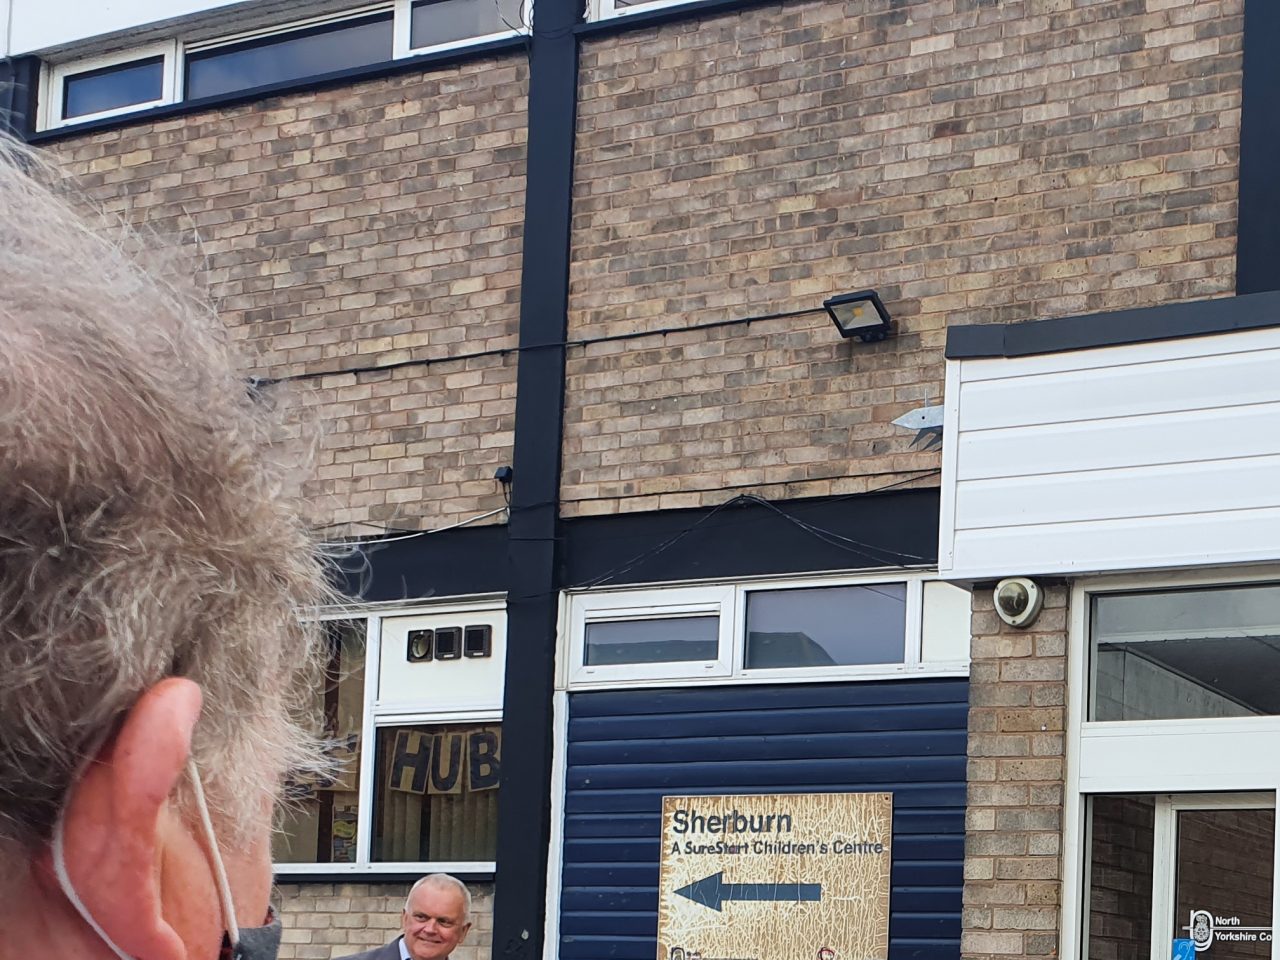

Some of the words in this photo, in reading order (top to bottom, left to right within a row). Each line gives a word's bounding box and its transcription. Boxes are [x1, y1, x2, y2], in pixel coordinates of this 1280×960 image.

[390, 731, 501, 792] HUB
[673, 809, 791, 834] Sherburn
[671, 841, 681, 856] A
[685, 841, 749, 855] SureStart
[753, 840, 828, 855] Children's
[832, 840, 884, 855] Centre
[1215, 916, 1240, 926] North
[1215, 932, 1257, 942] Yorkshire
